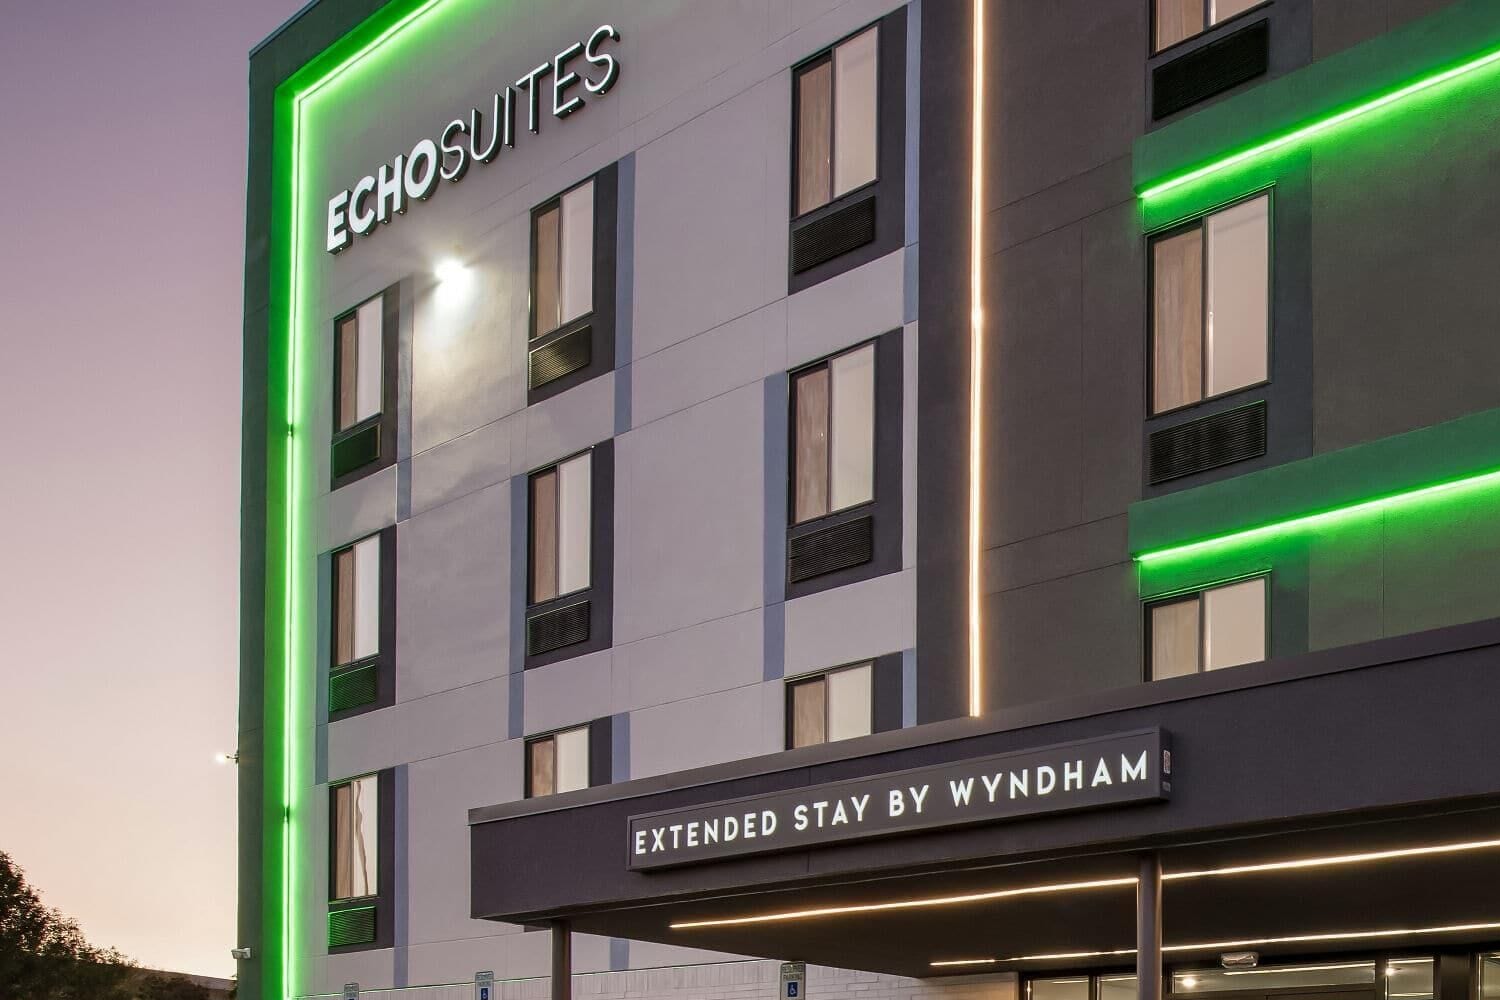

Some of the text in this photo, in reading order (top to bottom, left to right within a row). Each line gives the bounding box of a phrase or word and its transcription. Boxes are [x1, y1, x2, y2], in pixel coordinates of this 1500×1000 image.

[326, 23, 621, 256] ECHOSUITES
[634, 749, 1148, 855] EXTENDED STAY BY WYNDHAM
